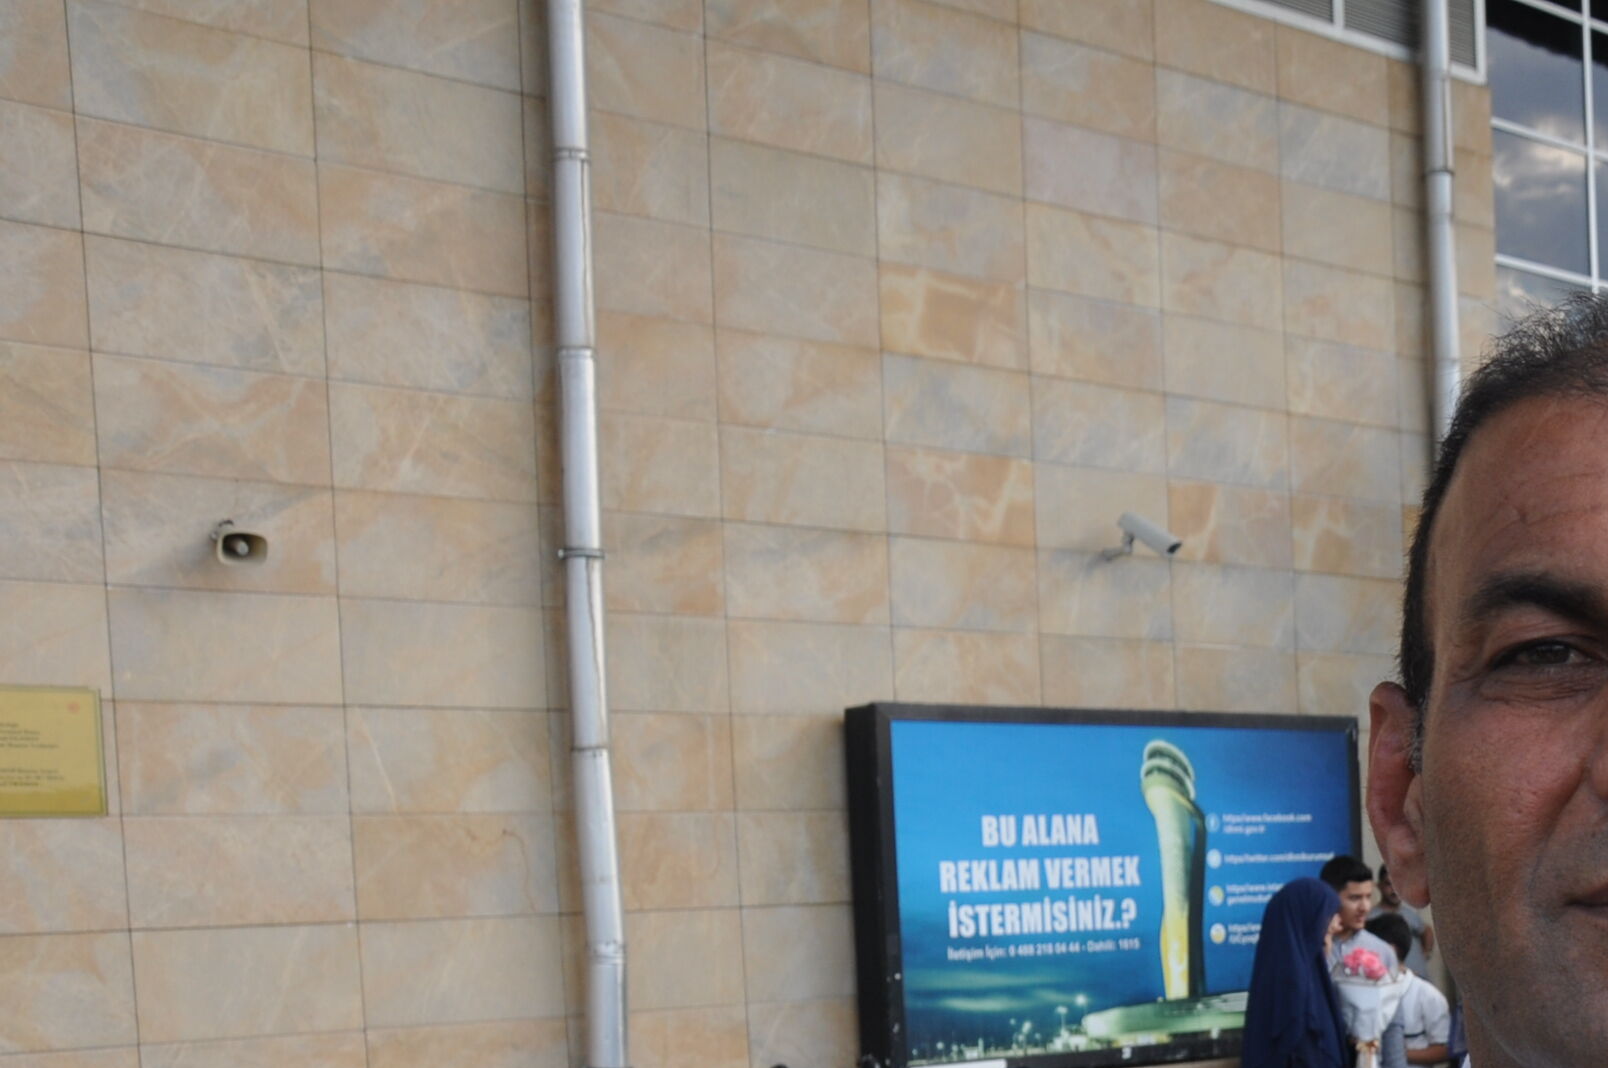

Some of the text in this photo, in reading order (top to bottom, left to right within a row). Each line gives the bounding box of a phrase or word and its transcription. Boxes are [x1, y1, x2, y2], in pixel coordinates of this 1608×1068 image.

[981, 813, 1099, 848] BU ALANA
[939, 855, 1141, 894] REKLAM VERMEK
[948, 894, 1137, 939] İSTERMİSİNİZ.?
